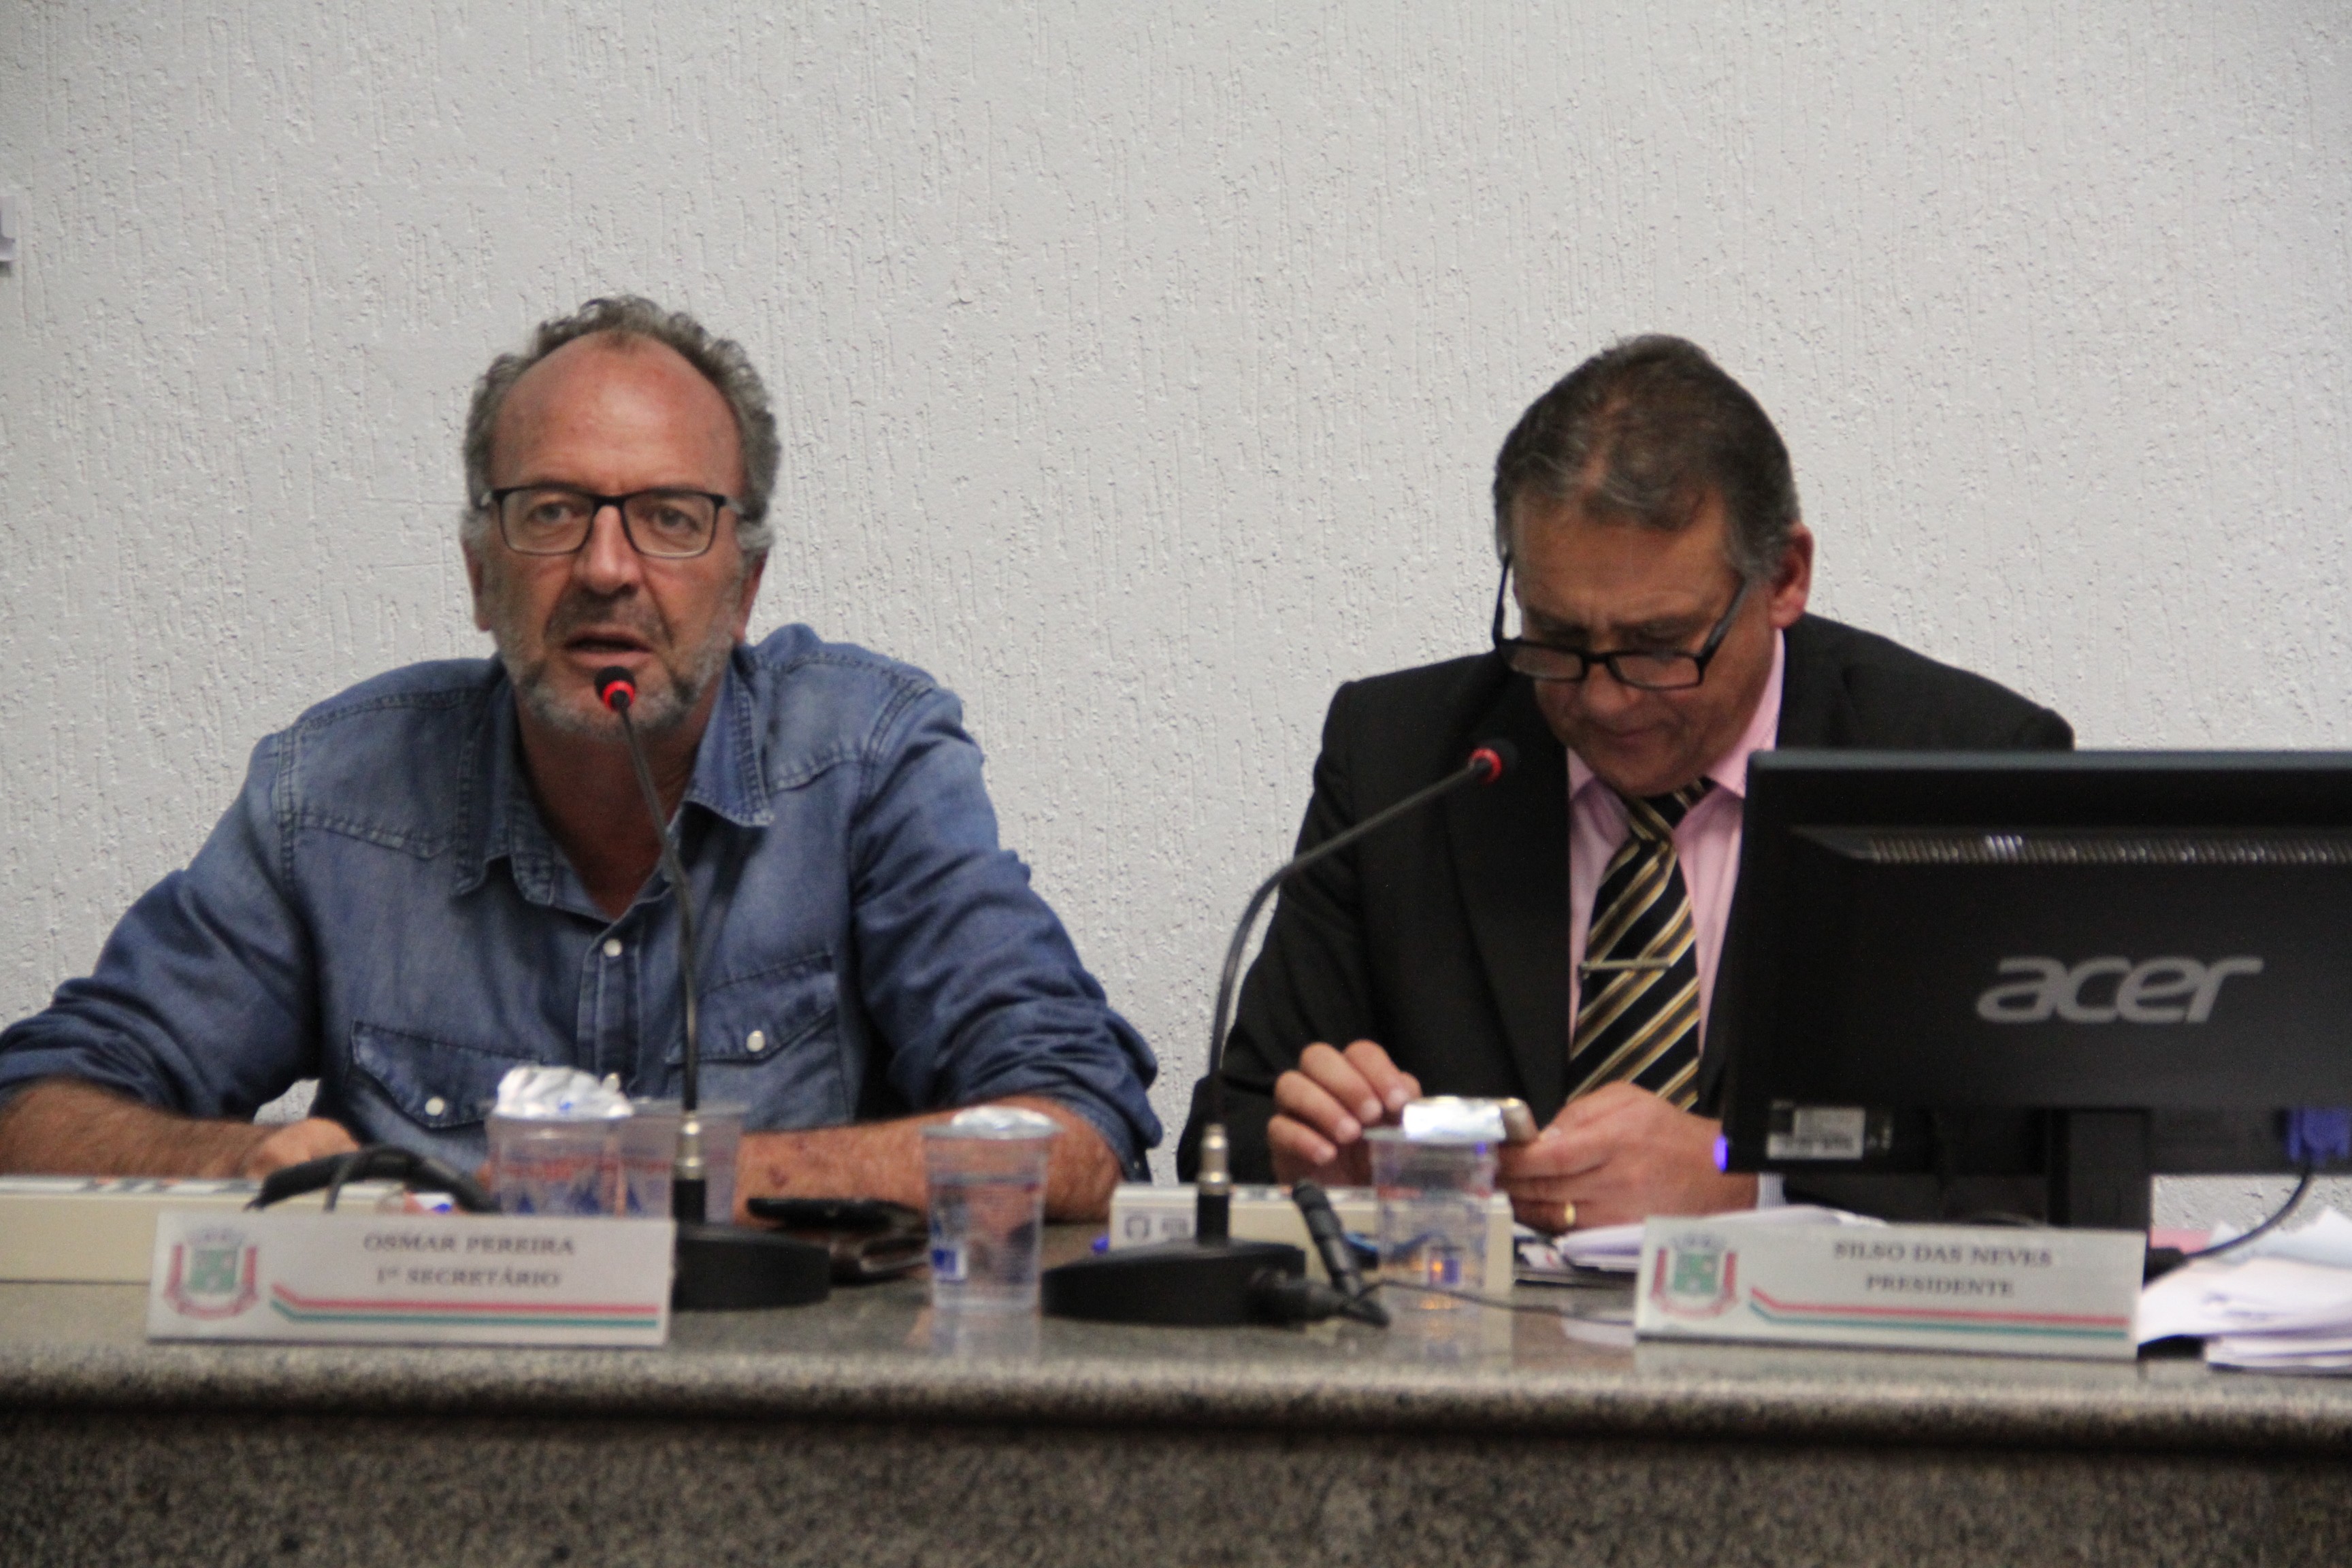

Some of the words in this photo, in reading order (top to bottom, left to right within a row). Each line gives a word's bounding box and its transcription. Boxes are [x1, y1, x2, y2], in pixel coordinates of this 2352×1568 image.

[1976, 956, 2264, 1024] acer
[363, 1232, 458, 1254] OSMAR
[465, 1235, 575, 1256] PEREIRA
[1912, 1243, 1963, 1264] DAS
[1971, 1245, 2052, 1269] NEVES
[408, 1265, 561, 1288] SECRETÁRIO
[1865, 1273, 2014, 1298] PRESIDENTE
